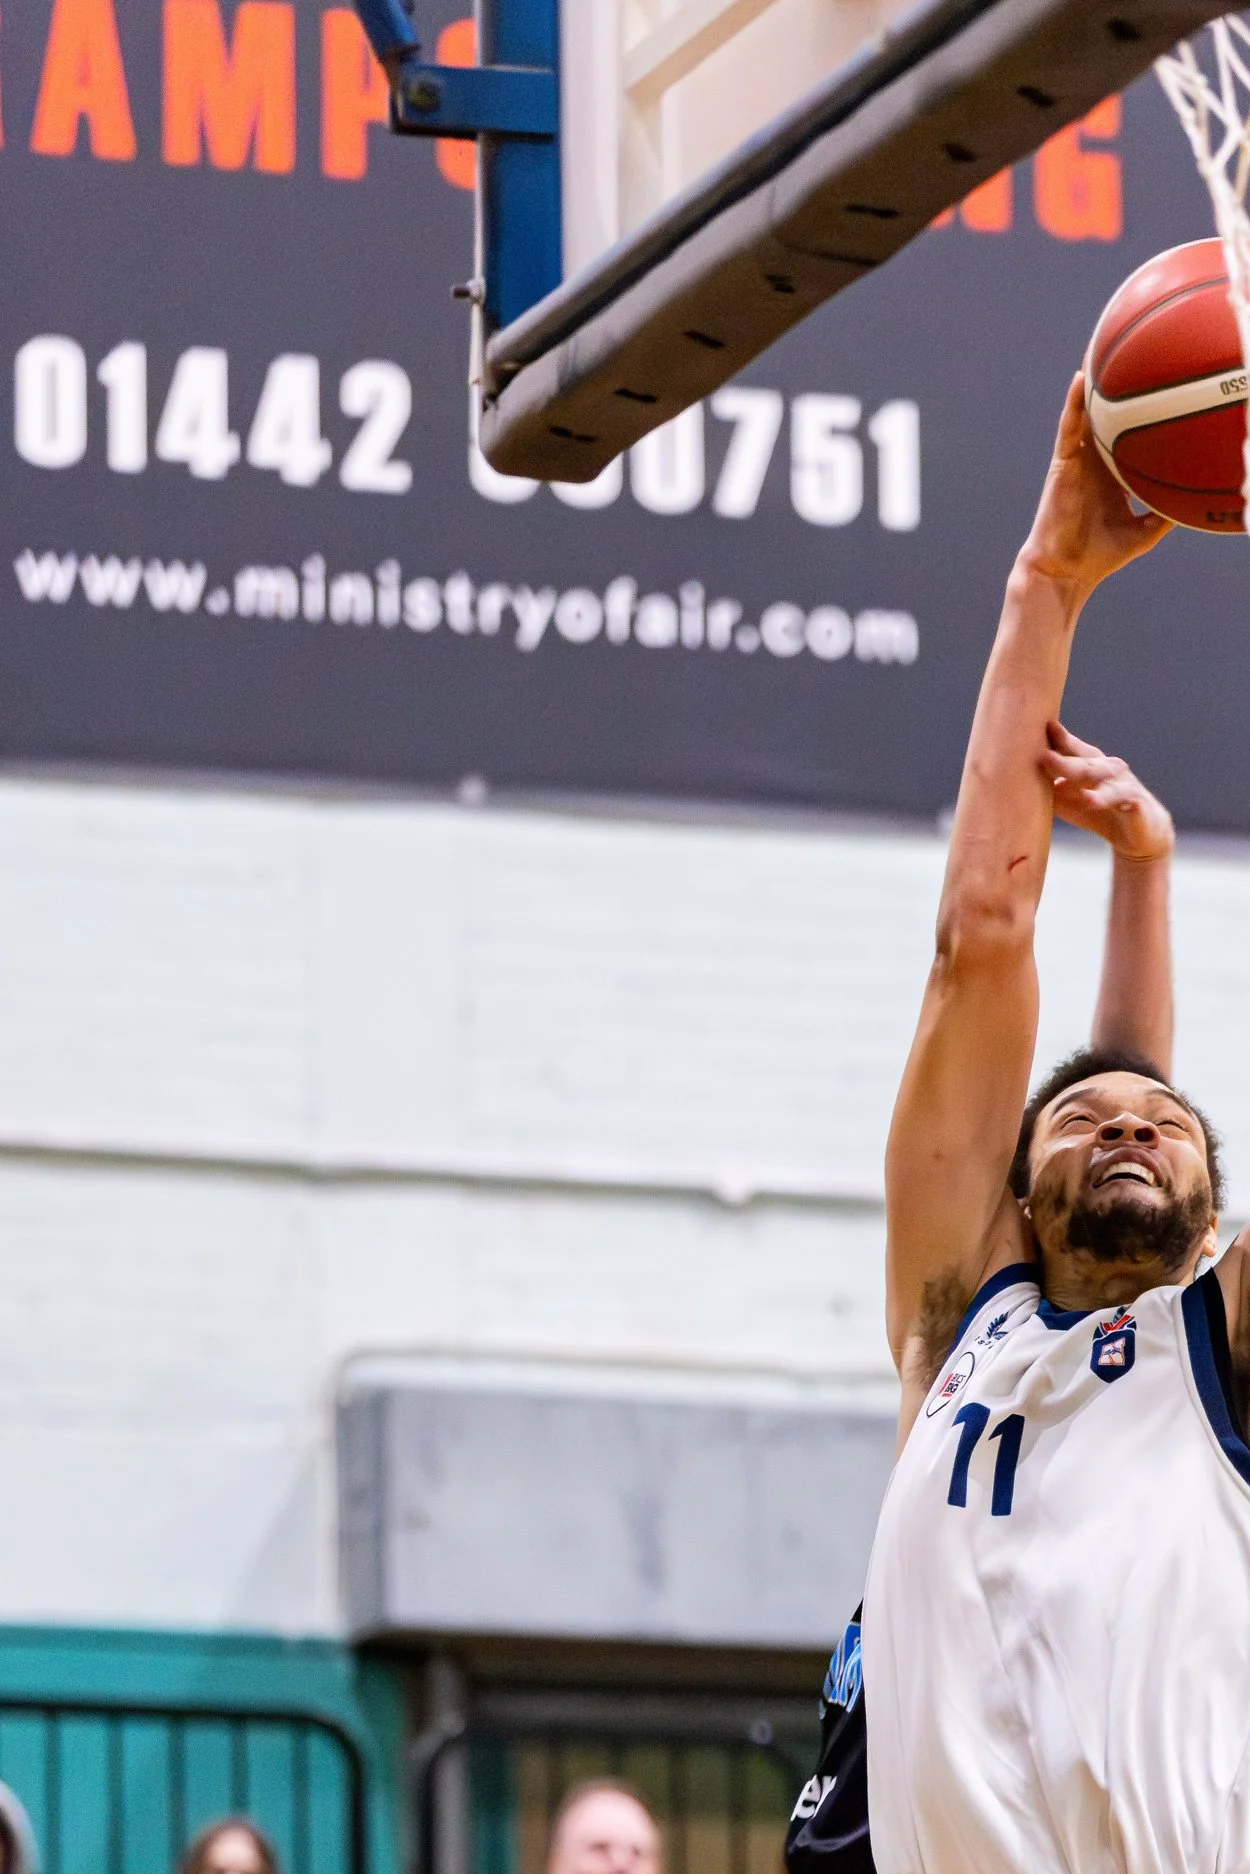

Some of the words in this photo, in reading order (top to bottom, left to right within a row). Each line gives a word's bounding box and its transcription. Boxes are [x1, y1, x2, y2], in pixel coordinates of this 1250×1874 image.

[13, 334, 413, 495] 01442
[469, 386, 922, 531] 0751
[13, 548, 921, 666] www.ministryofair.com
[946, 1402, 1026, 1517] 11
